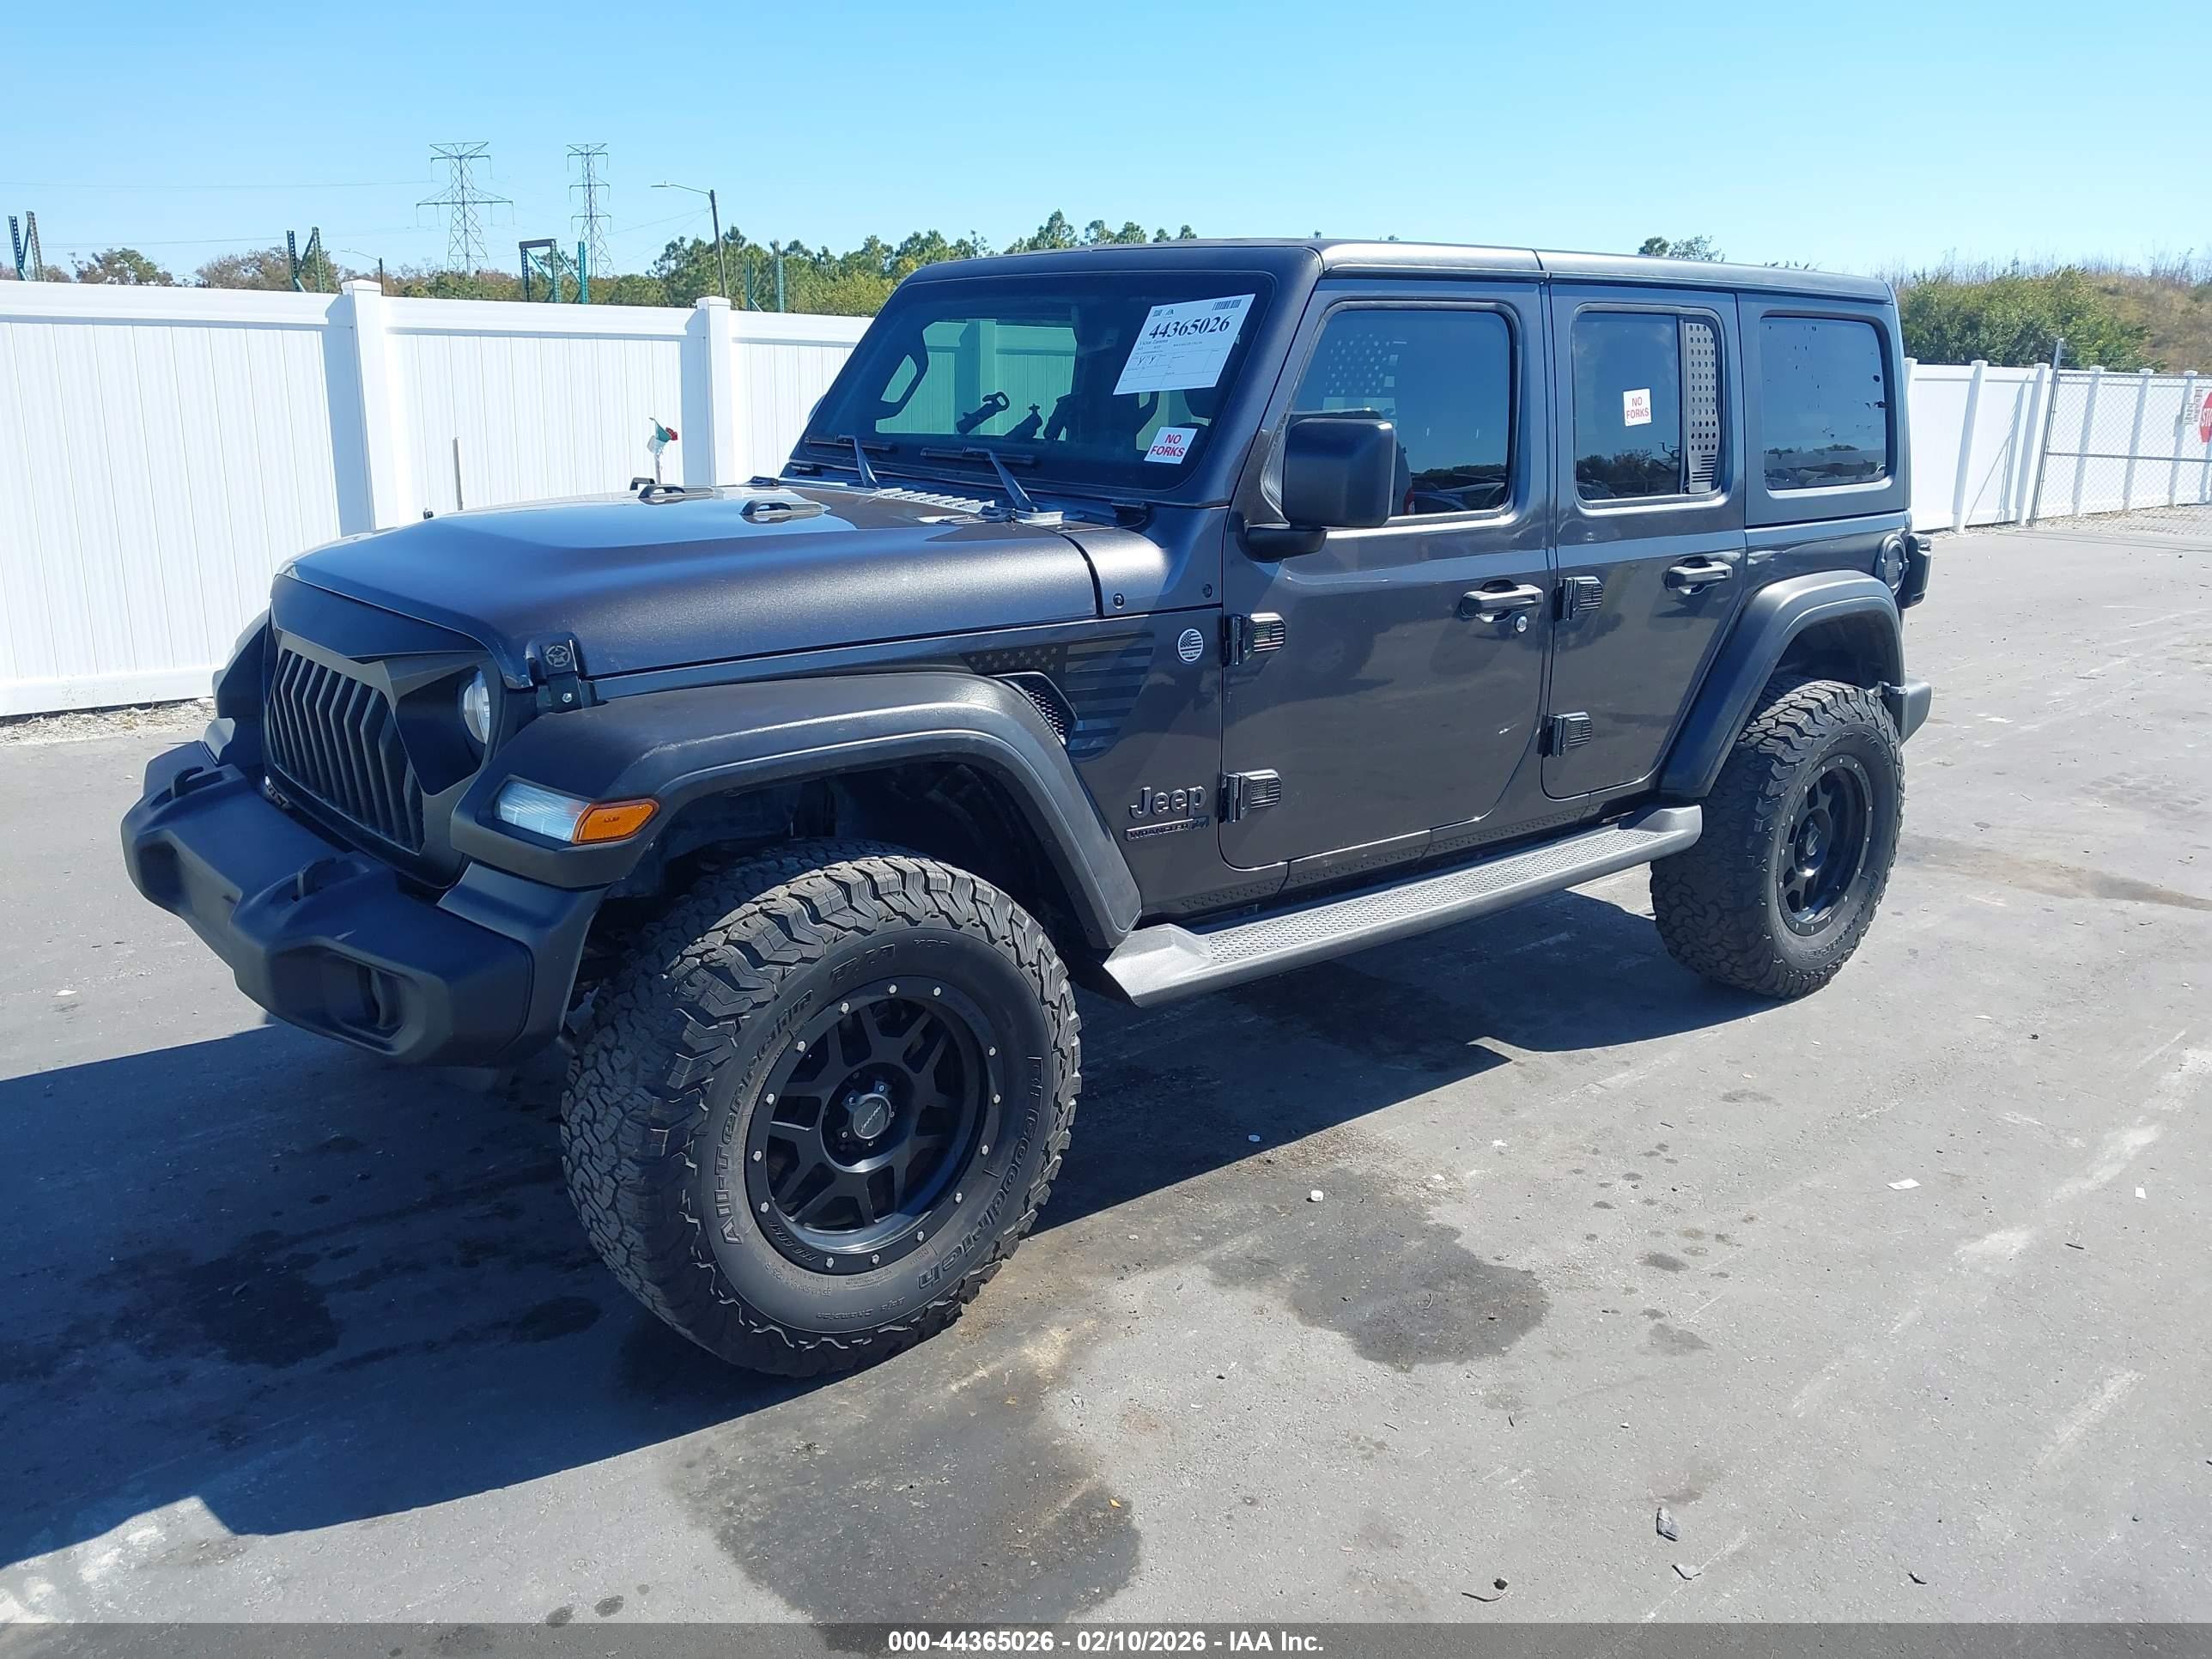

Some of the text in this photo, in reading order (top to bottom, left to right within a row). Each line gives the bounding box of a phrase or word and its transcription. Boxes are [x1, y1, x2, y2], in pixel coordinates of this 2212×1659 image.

[1149, 314, 1234, 339] 44365026
[1632, 397, 1643, 407] NO
[1626, 407, 1650, 419] FORKS
[1164, 434, 1182, 445] NO
[1150, 445, 1186, 457] FORKS
[1129, 786, 1207, 819] Jeep
[1129, 823, 1189, 839] WRANGLER
